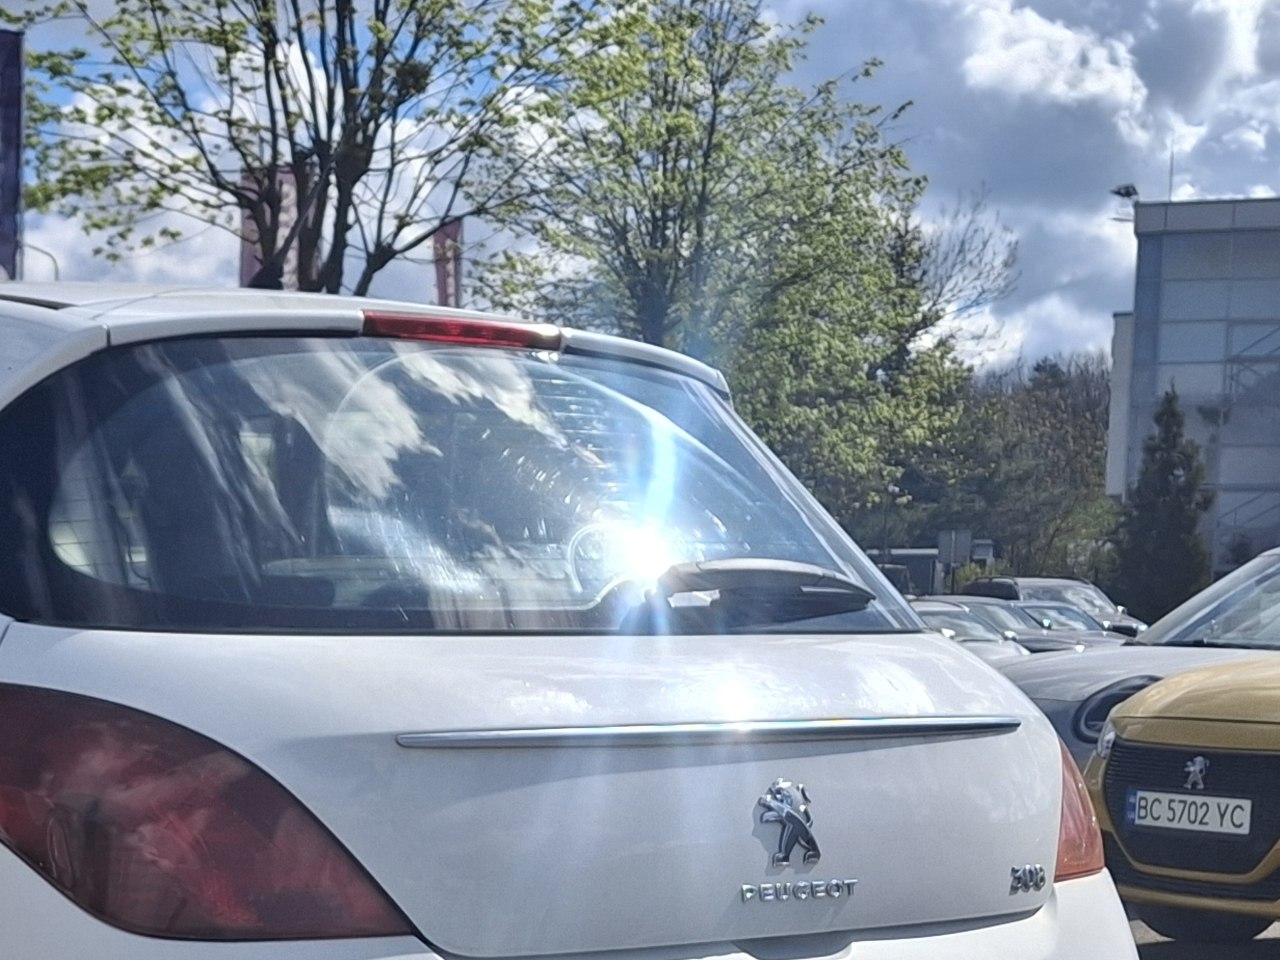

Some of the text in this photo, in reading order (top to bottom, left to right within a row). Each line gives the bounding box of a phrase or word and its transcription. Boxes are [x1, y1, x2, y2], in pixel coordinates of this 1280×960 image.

[1137, 796, 1245, 829] BC 5702 YC
[741, 878, 858, 902] PEUGEOT
